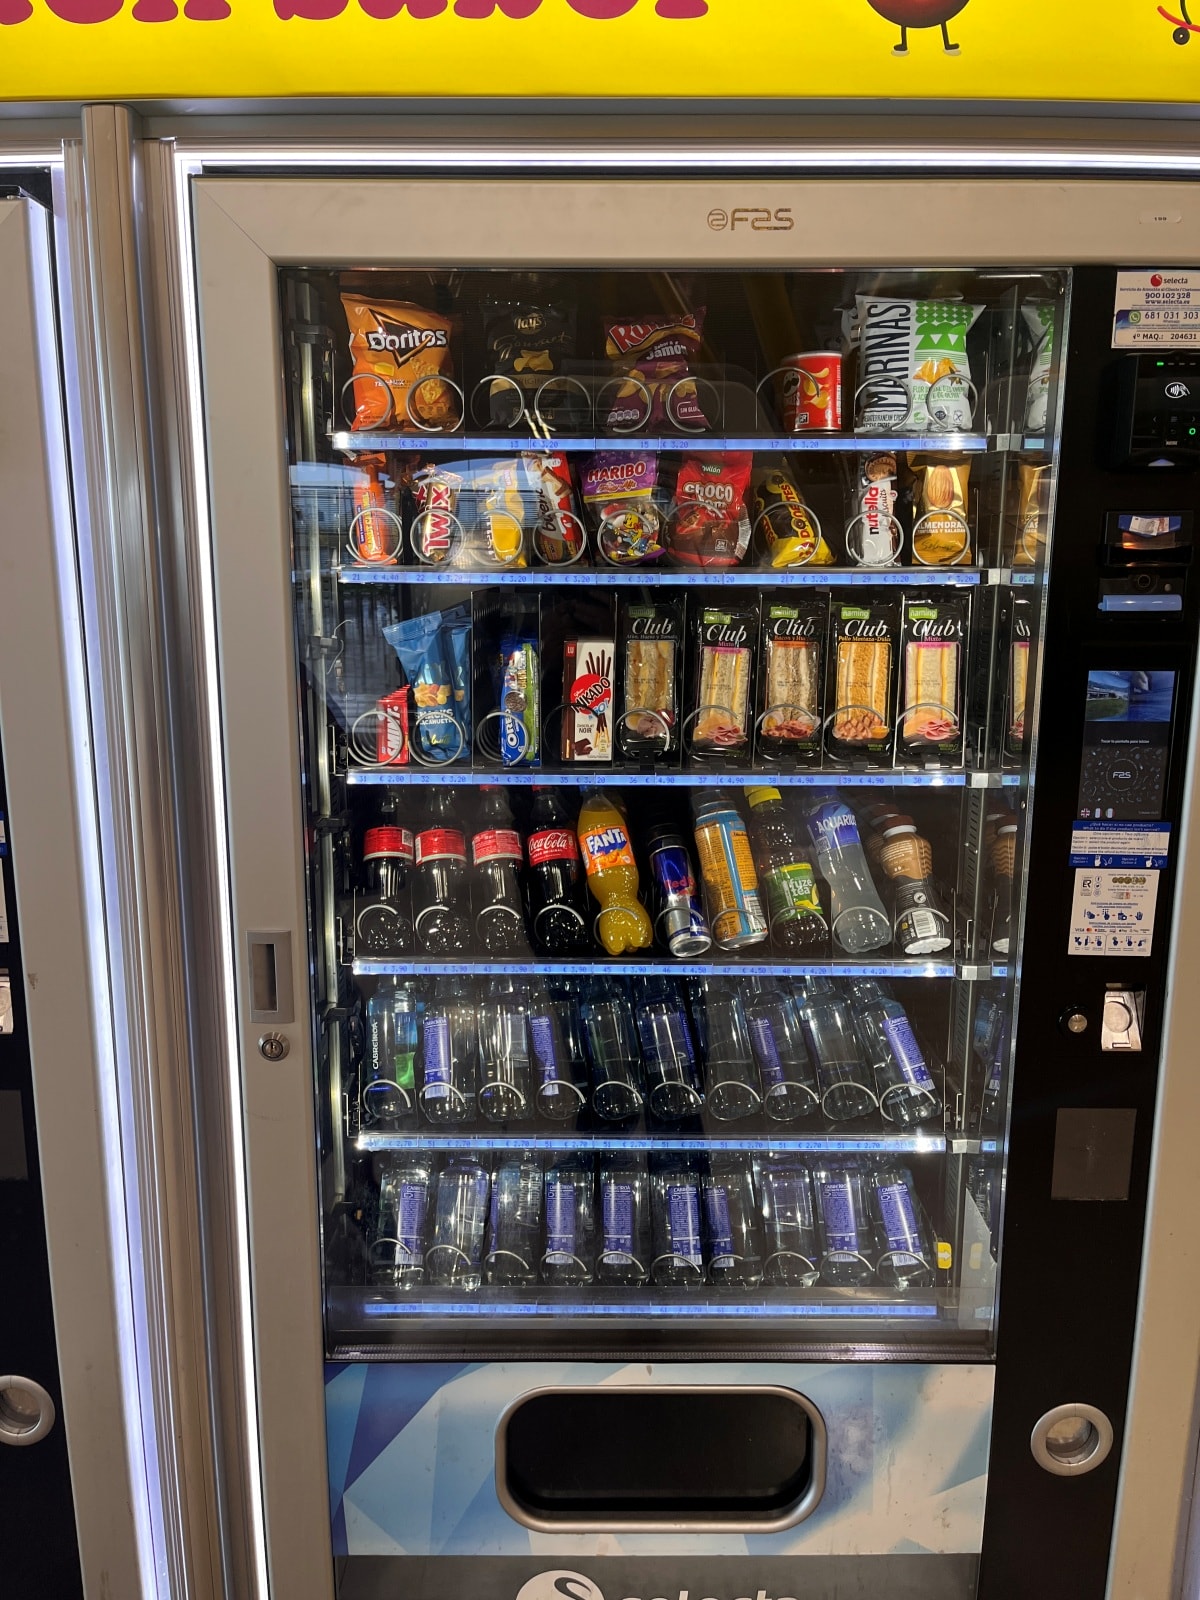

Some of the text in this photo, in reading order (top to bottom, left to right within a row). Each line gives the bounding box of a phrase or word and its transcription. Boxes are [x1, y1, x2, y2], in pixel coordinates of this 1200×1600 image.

[1176, 292, 1191, 300] 328
[1145, 312, 1198, 320] 681 031 303
[368, 329, 447, 351] Doritos
[588, 461, 646, 482] HARIBO
[780, 484, 811, 538] DONETES
[864, 486, 879, 535] nutella
[423, 486, 450, 557] TWIX
[632, 618, 673, 635] Club
[706, 624, 747, 642] Club
[773, 619, 814, 636] Club
[844, 619, 887, 637] Club
[912, 619, 955, 637] Club
[567, 646, 575, 654] LU
[570, 676, 611, 713] MIKADO
[503, 709, 518, 748] OREO
[529, 832, 567, 856] Coca-Cola
[585, 828, 627, 853] FANTA
[789, 877, 812, 890] fuze
[791, 886, 810, 897] tea
